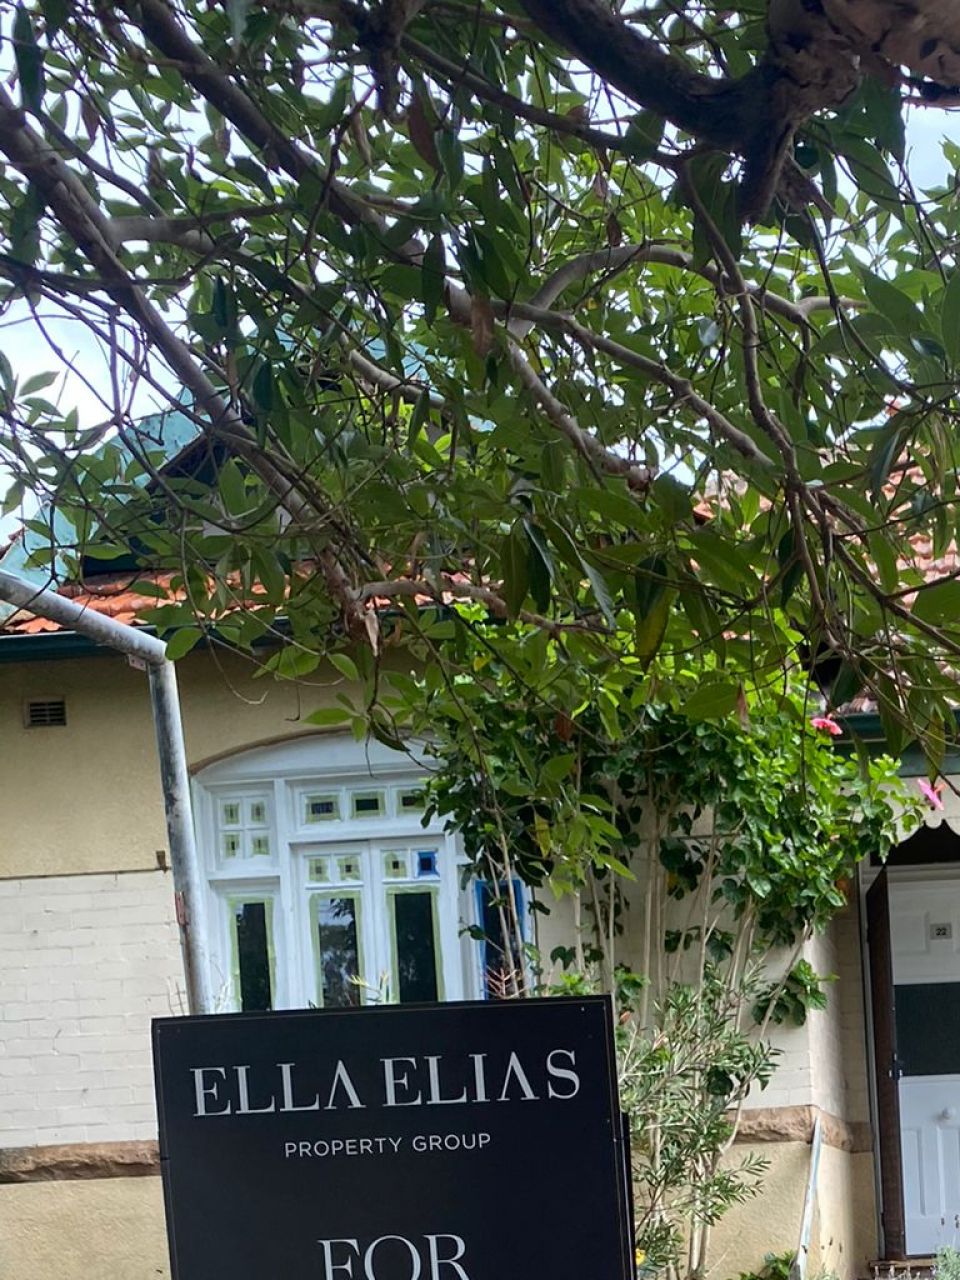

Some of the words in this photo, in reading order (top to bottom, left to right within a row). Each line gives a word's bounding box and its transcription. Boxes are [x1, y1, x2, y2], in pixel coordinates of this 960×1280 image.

[190, 1060, 365, 1116] ELLA
[380, 1050, 579, 1106] ELIAS
[285, 1137, 402, 1157] PROPERTY
[413, 1133, 490, 1151] GROUP
